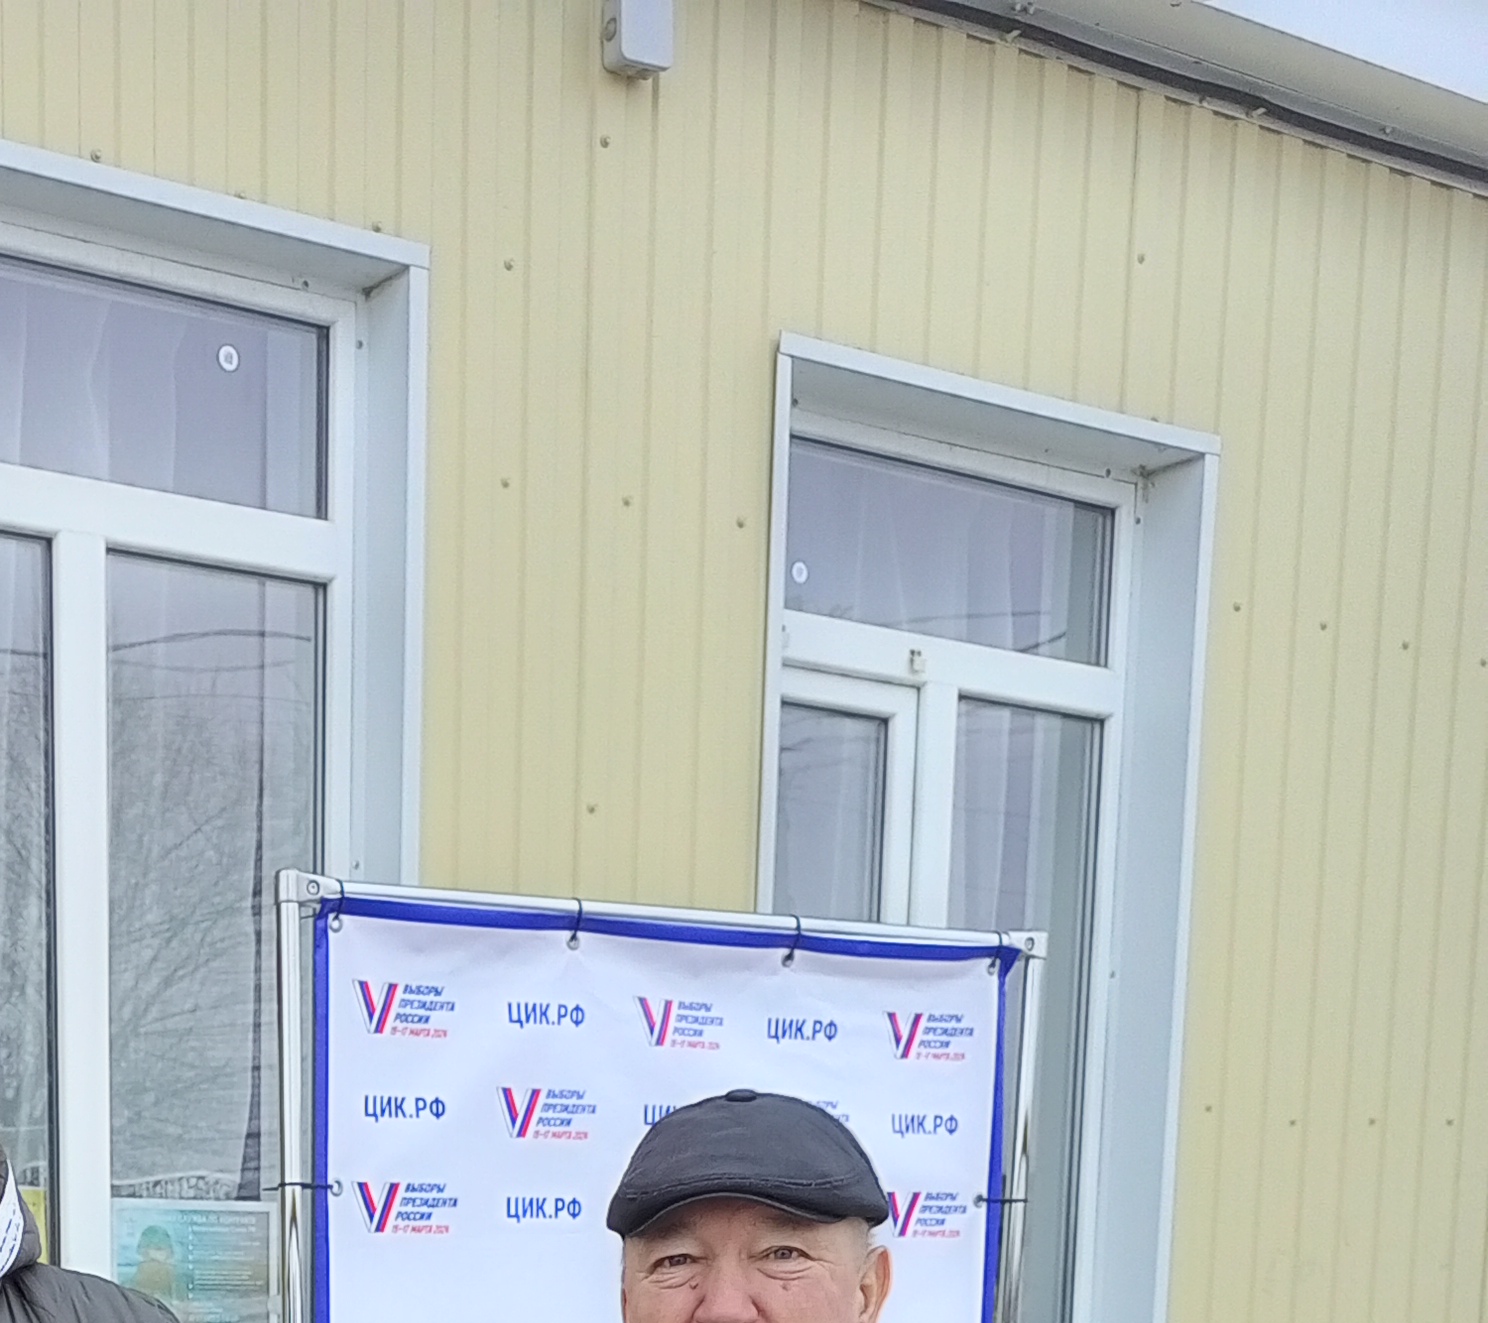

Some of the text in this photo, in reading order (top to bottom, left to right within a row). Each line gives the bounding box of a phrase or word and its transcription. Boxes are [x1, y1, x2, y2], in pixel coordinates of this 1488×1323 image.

[507, 1001, 586, 1029] ЦИК.РФ
[767, 1017, 838, 1044] ЦИК.РФ
[364, 1095, 446, 1123] ЦИК.РФ
[892, 1113, 959, 1139] ЦИК.РФ
[404, 1182, 447, 1193] ВЫБОРЫ
[399, 1197, 459, 1208] ПРЕЗИДЕНТА
[506, 1197, 582, 1223] ЦИК.РФ
[395, 1211, 433, 1221] РОССИИ
